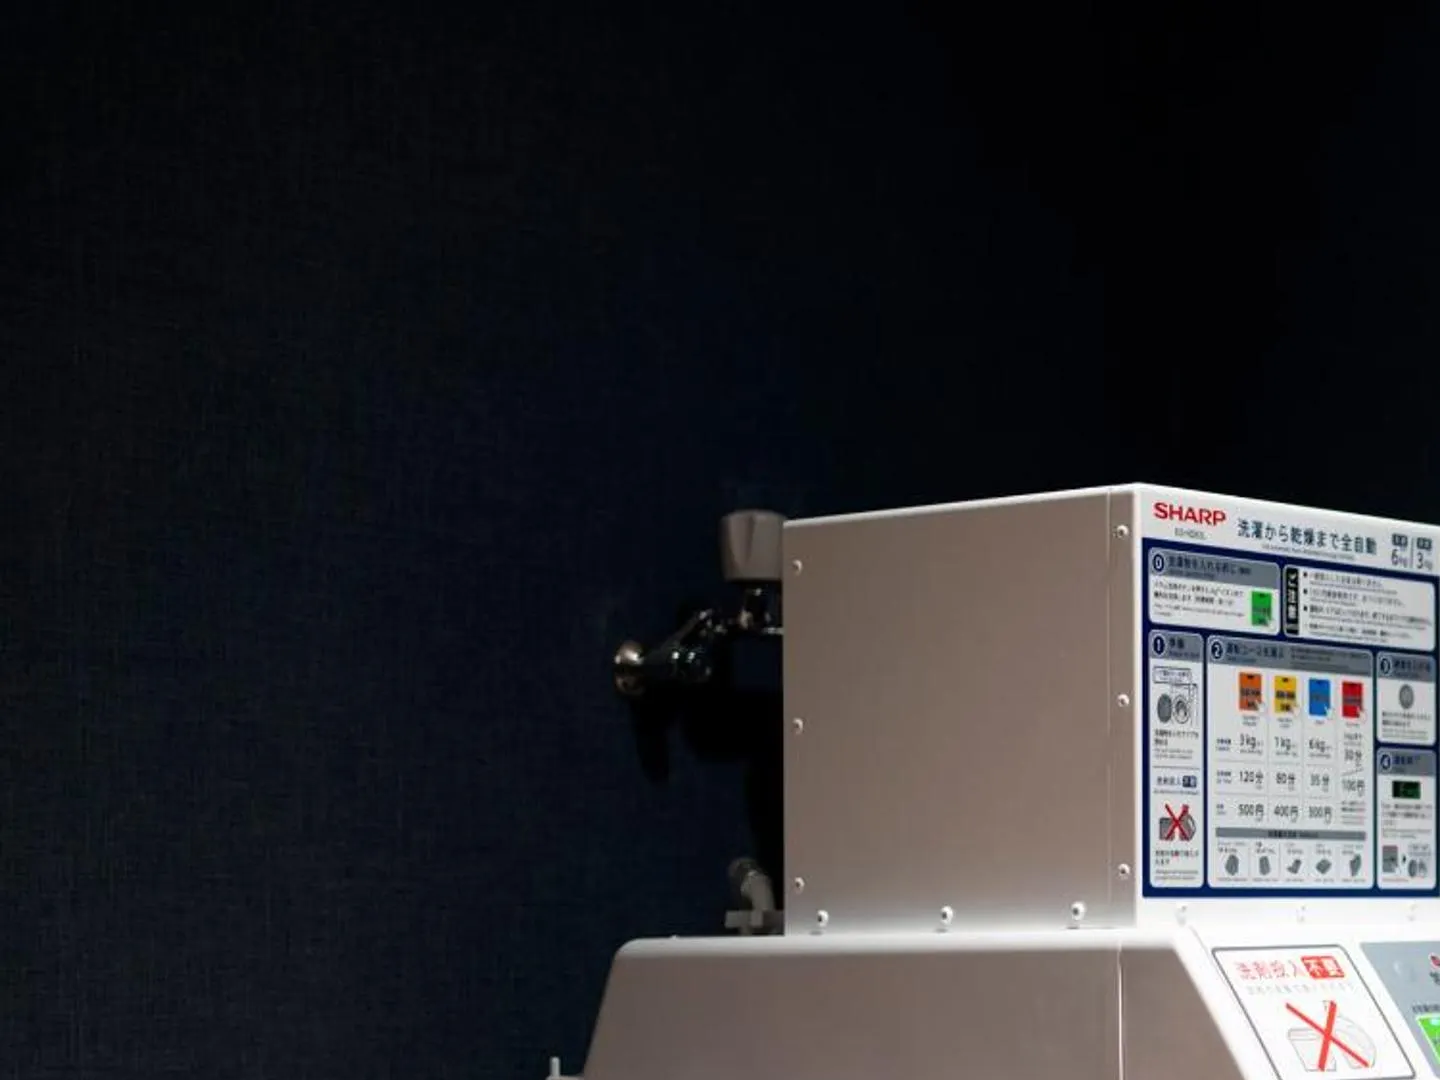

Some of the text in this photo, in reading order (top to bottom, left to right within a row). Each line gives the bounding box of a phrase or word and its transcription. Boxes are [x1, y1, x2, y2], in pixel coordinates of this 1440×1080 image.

[1153, 502, 1227, 526] SHARP
[1237, 517, 1378, 556] 洗濯から乾燥まで全自動
